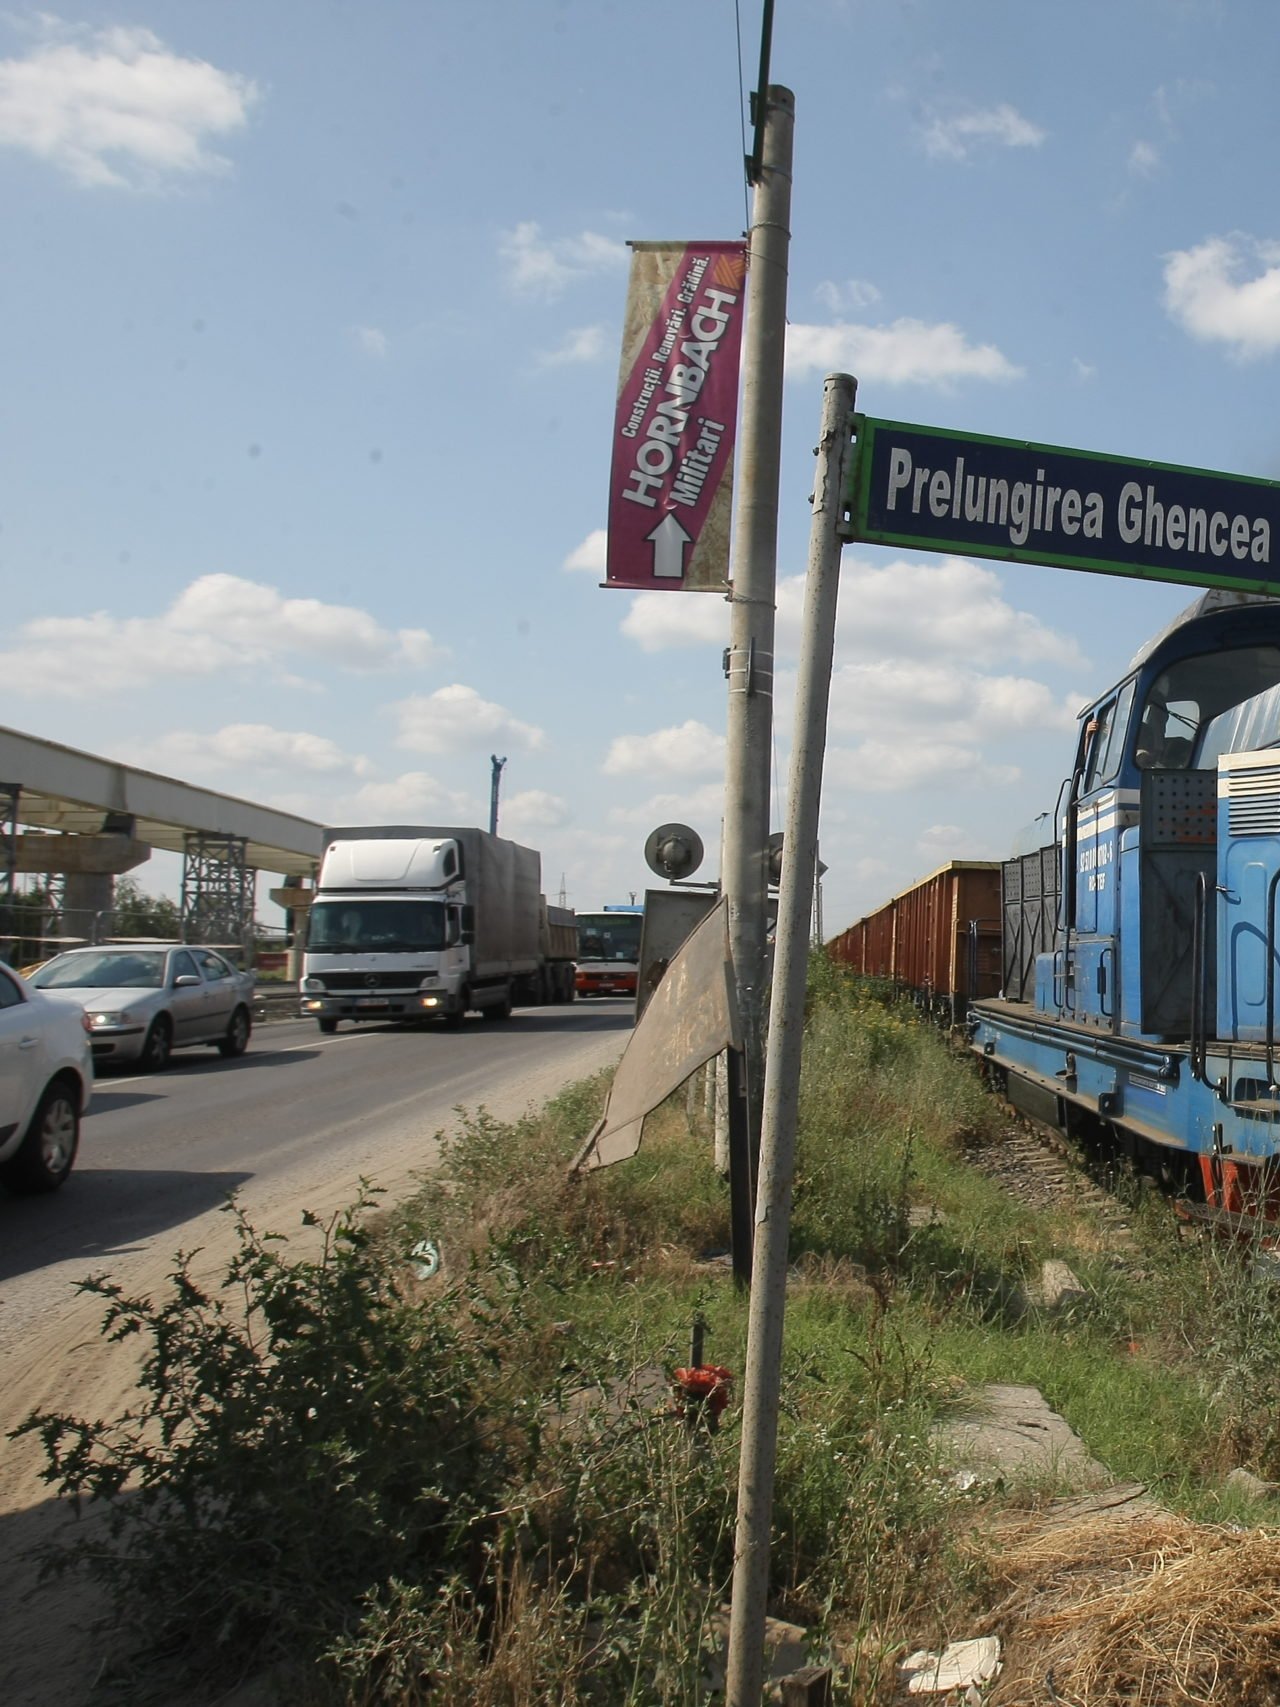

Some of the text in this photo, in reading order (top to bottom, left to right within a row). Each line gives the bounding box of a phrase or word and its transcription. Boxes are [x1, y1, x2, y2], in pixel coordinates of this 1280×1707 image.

[652, 308, 687, 363] Renovări.
[677, 257, 710, 304] Grădină.
[622, 288, 737, 508] HORNBACH
[669, 416, 726, 507] Militari
[886, 447, 1271, 564] Prelungirea Ghencea
